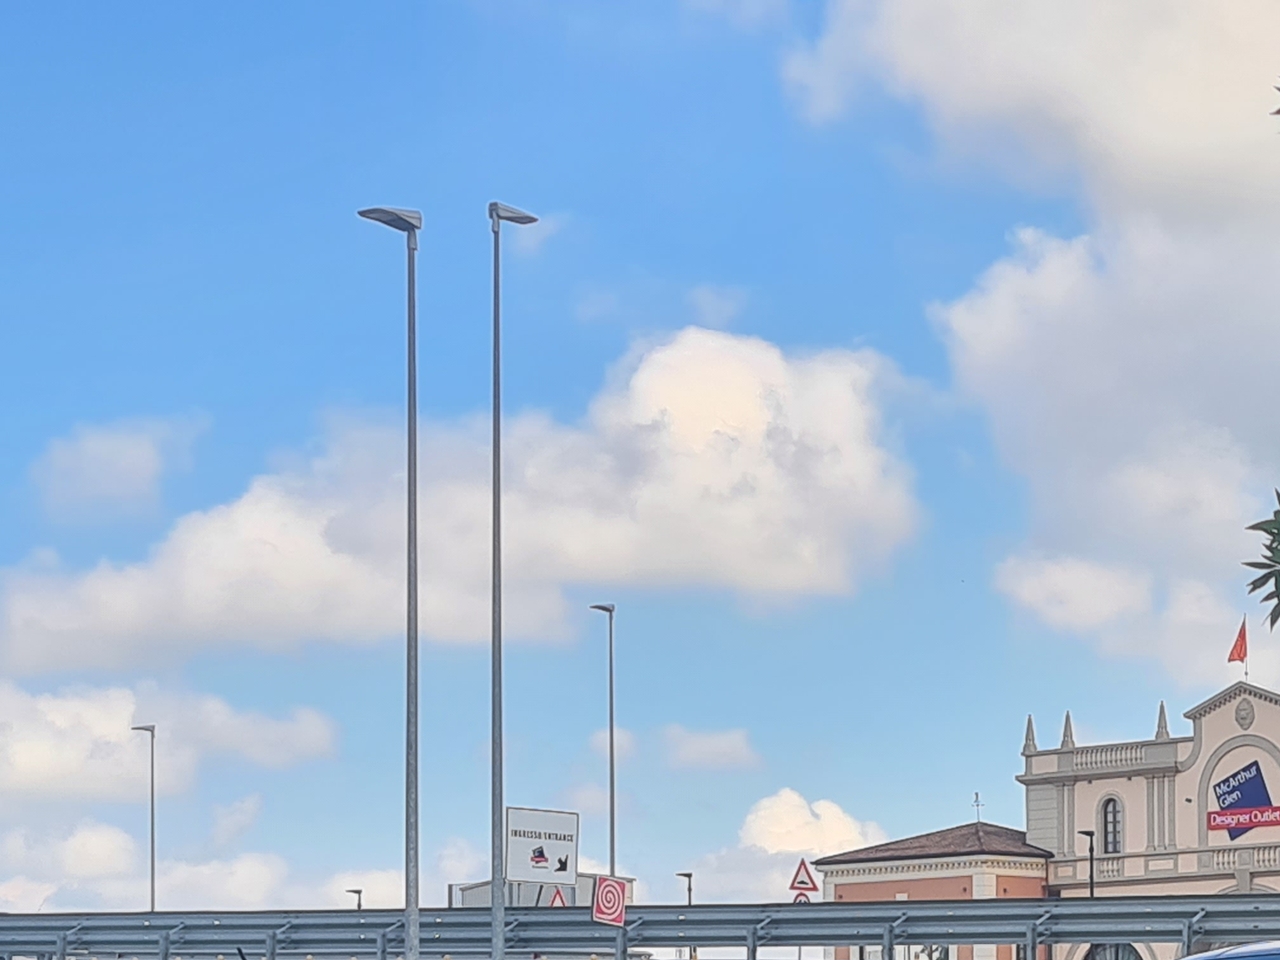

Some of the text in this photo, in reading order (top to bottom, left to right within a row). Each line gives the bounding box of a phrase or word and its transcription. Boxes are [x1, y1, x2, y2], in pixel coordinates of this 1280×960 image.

[1215, 766, 1257, 797] McArthur
[1219, 791, 1242, 808] Glen
[1210, 809, 1280, 827] Designer Outlet
